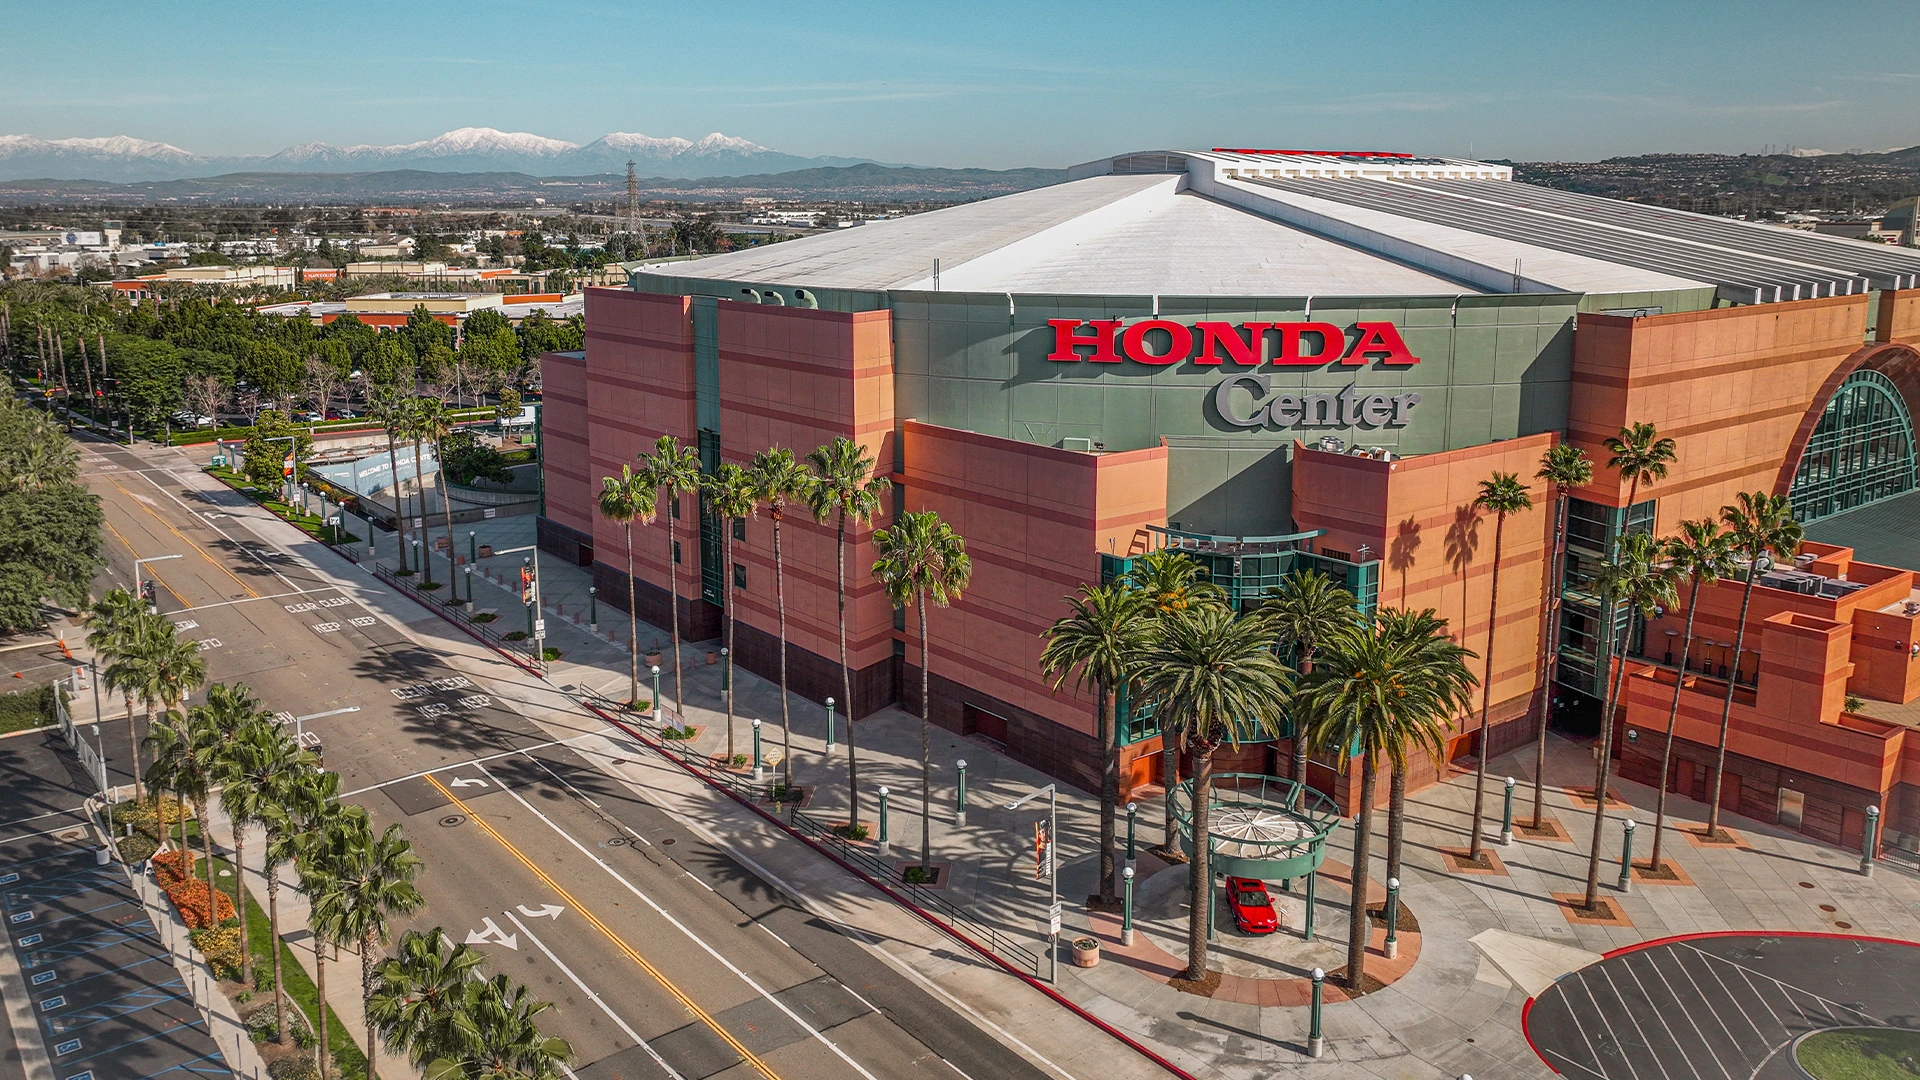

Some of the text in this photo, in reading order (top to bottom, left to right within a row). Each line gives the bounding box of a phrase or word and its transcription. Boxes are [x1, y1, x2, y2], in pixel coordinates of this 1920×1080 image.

[1047, 319, 1421, 365] HONDA
[1215, 374, 1422, 427] Center
[359, 465, 381, 478] WELCOME
[284, 597, 353, 613] CLEAR CLEAR
[312, 616, 376, 634] KEEP KEEP
[390, 677, 474, 700] CLEAR CLEAR
[416, 695, 492, 719] KEEP KEEP
